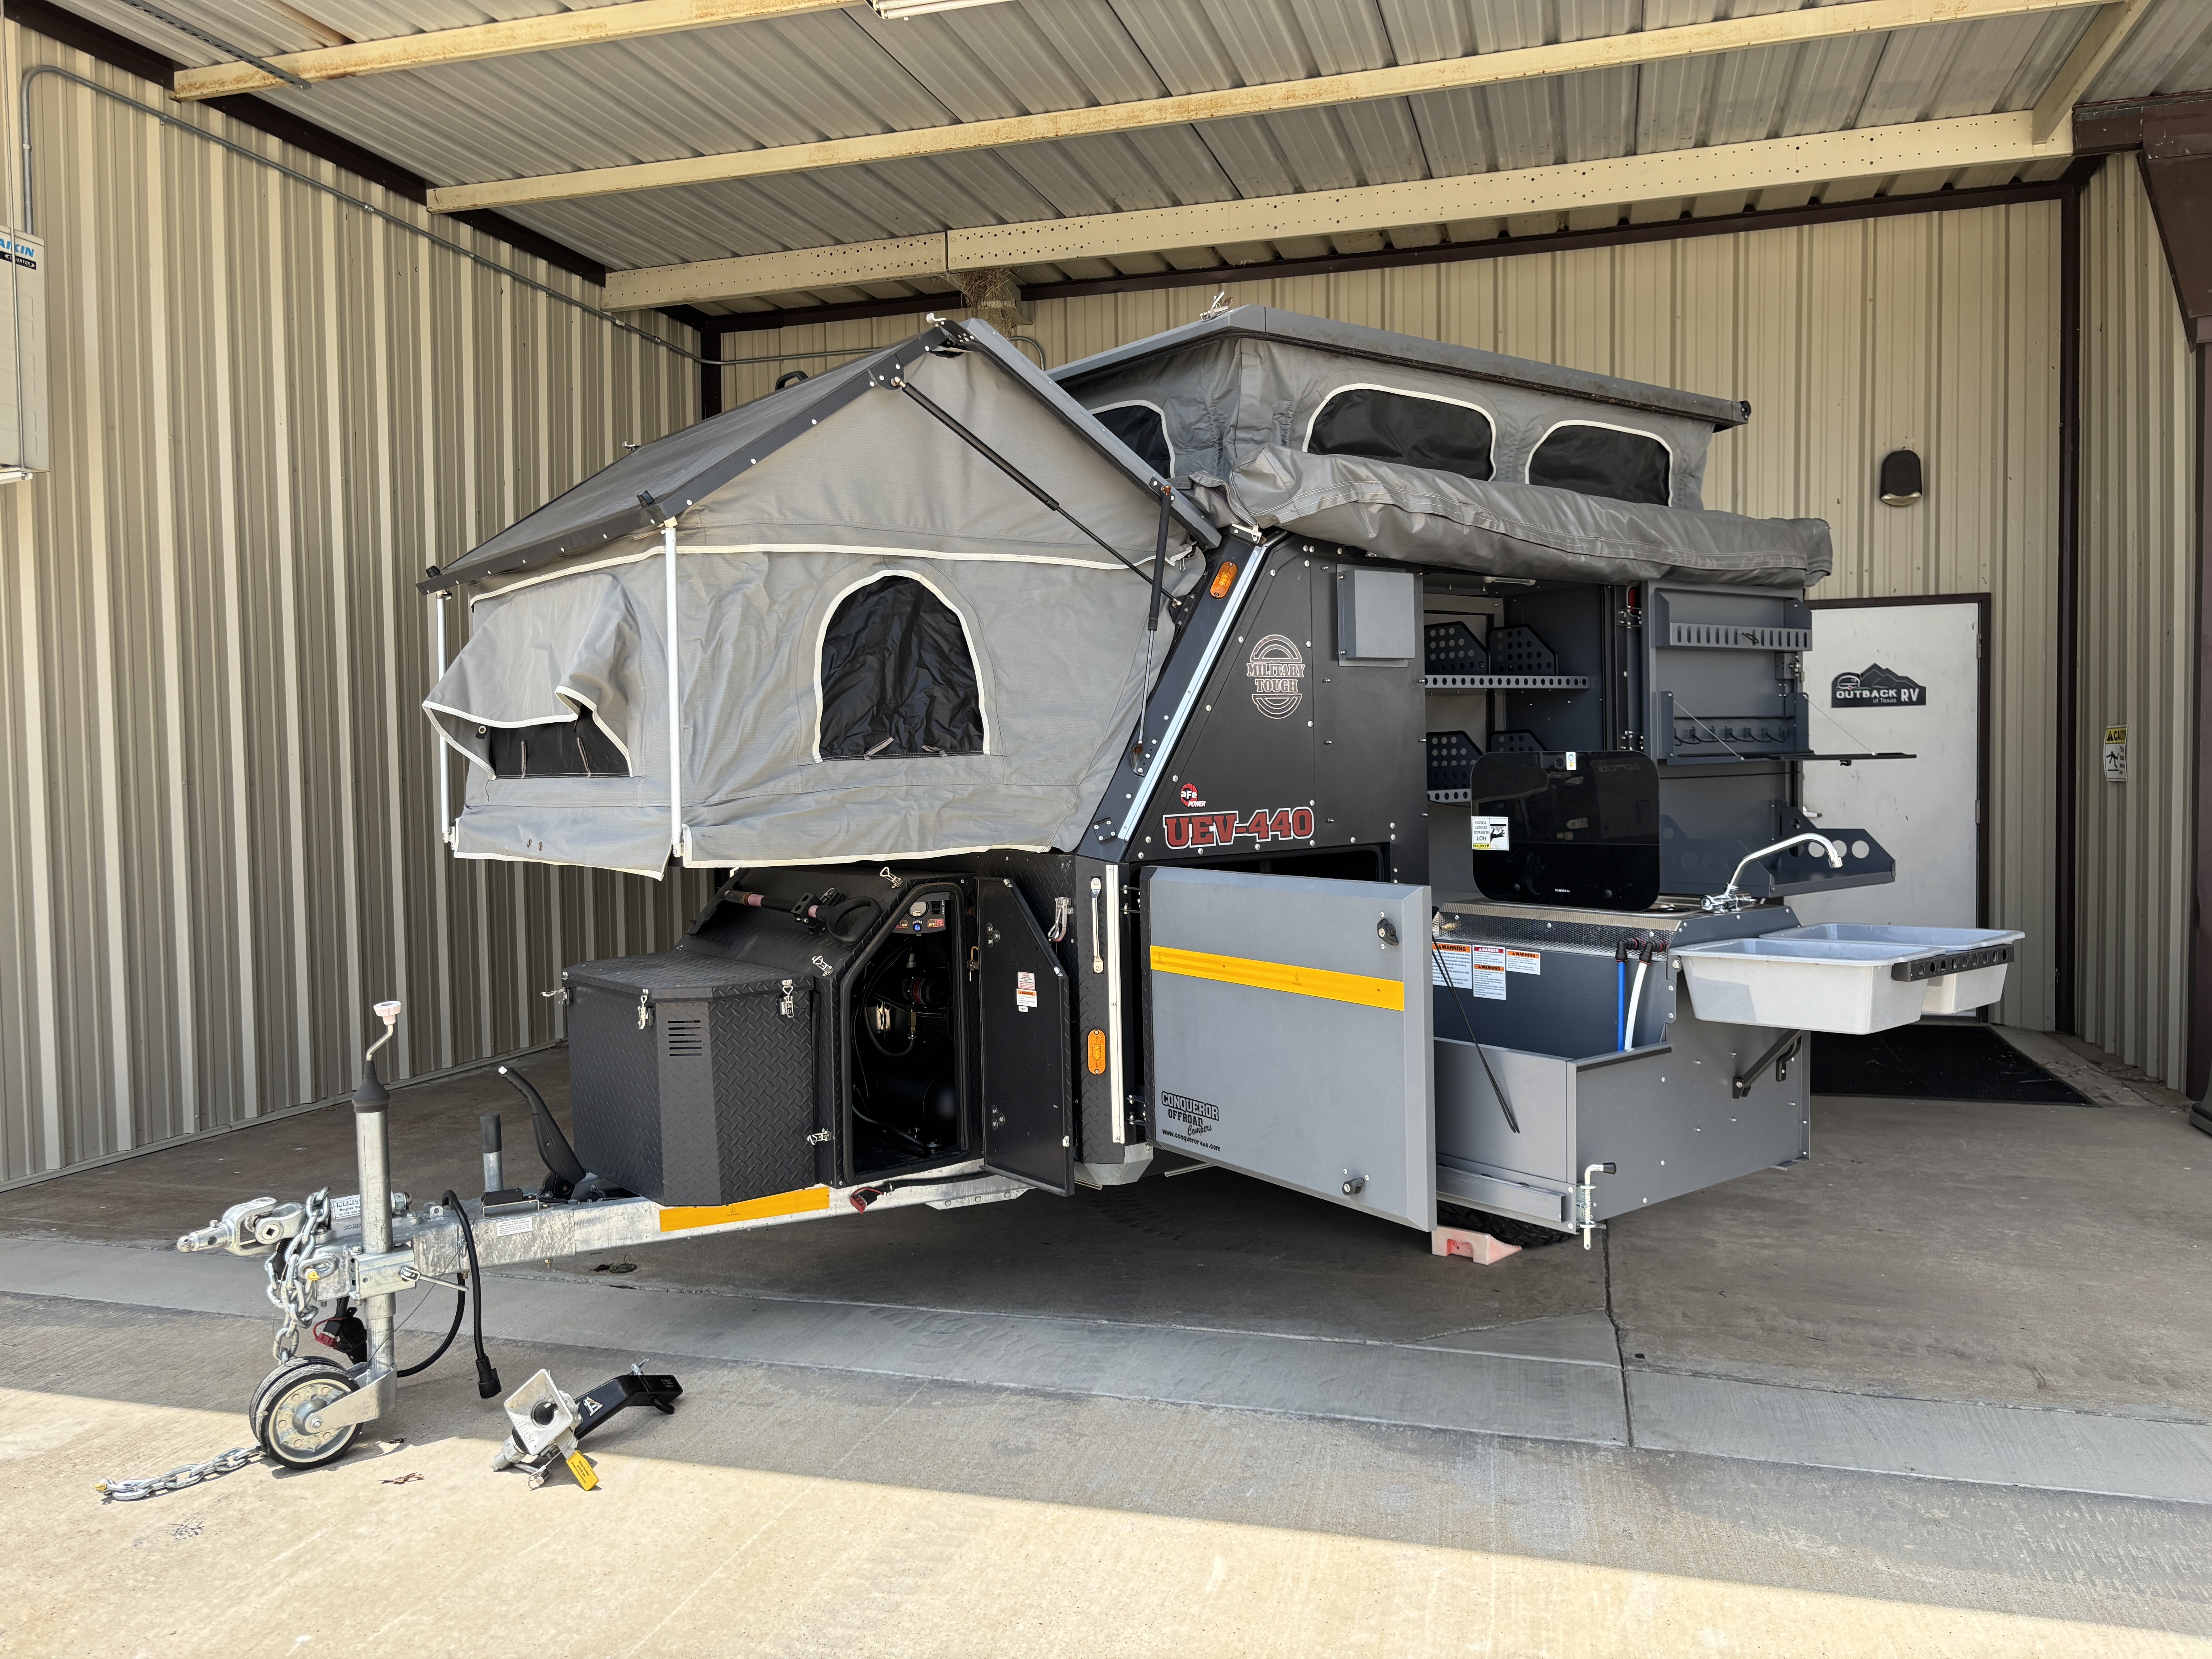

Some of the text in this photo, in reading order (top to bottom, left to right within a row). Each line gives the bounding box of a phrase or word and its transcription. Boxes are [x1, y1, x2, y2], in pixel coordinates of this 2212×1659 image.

[0, 238, 34, 257] AIKIN
[1247, 663, 1305, 677] MILITARY
[1255, 679, 1298, 693] TOUGH
[1836, 688, 1919, 702] OUTBACK RV
[1181, 790, 1197, 799] aFe
[1163, 807, 1314, 849] UEV-440
[1161, 1091, 1219, 1121] CONQUEROR
[1168, 1109, 1203, 1127] OFFROAD
[1188, 1125, 1212, 1136] Campers
